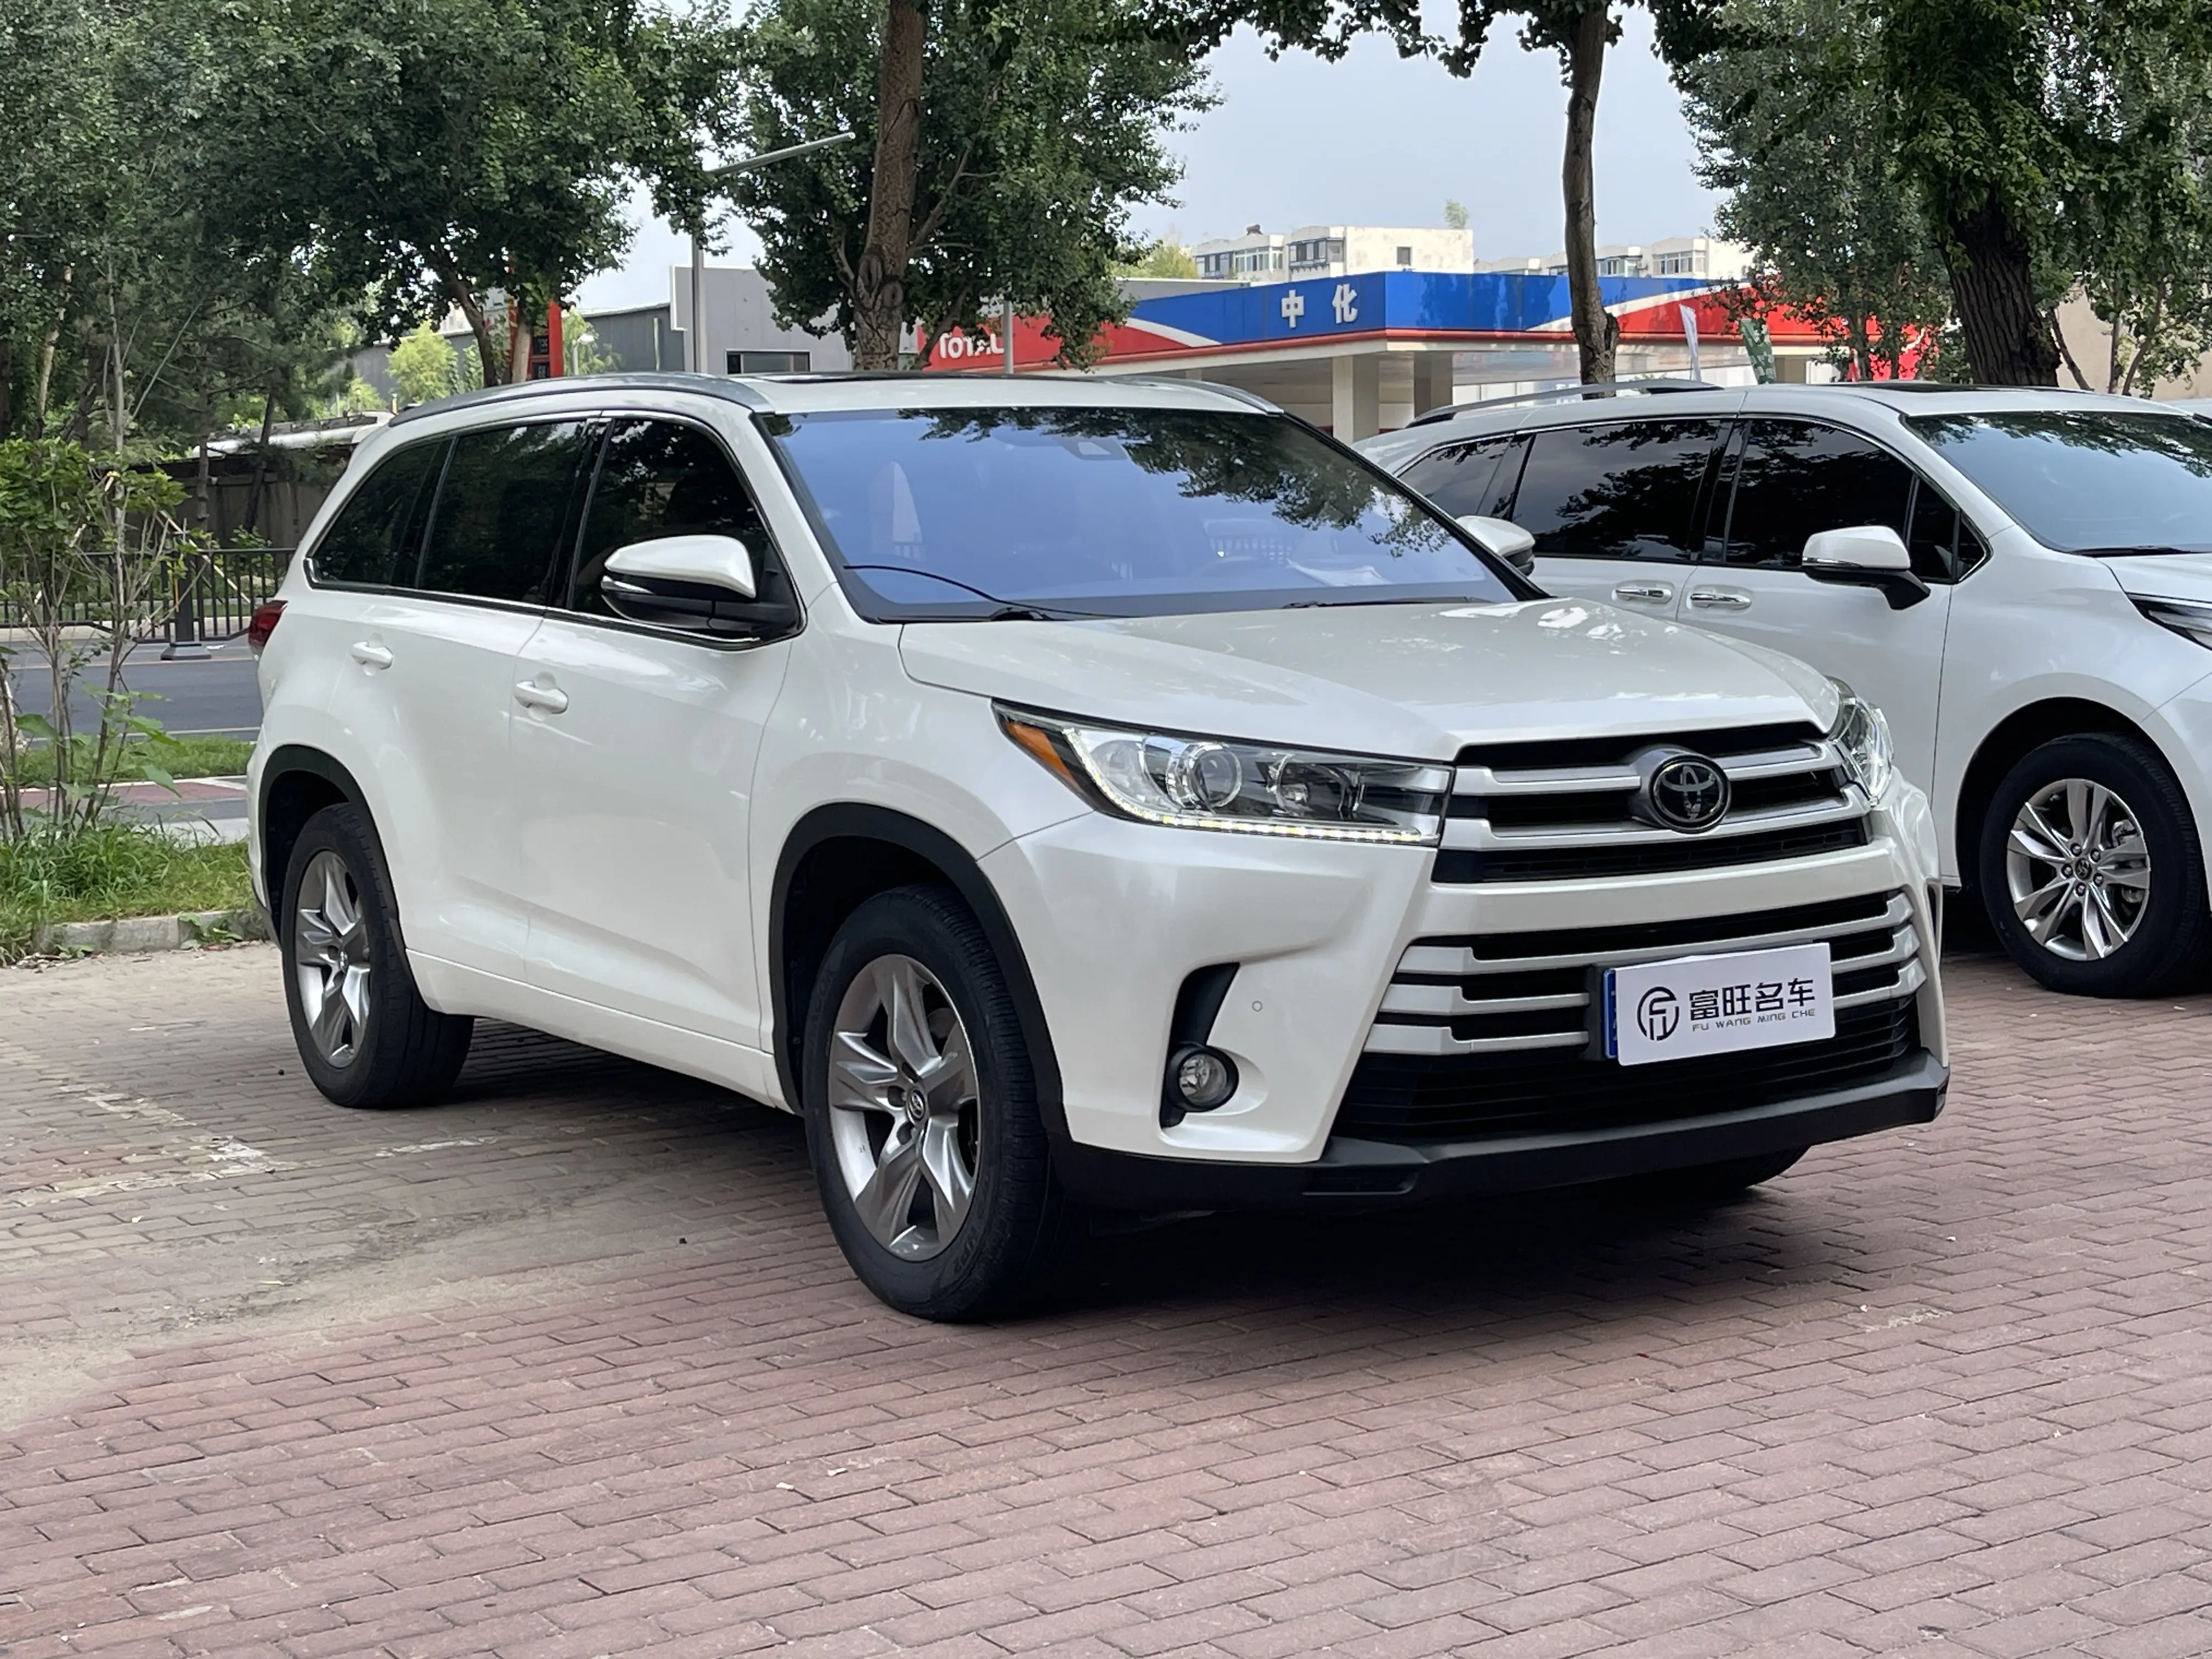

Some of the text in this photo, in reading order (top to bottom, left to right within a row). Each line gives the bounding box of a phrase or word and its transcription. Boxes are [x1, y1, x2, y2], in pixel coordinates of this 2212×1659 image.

[1281, 283, 1358, 329] 中化
[1689, 978, 1815, 1020] 富旺名车
[1692, 1008, 1816, 1032] FU WANG MING CHE
